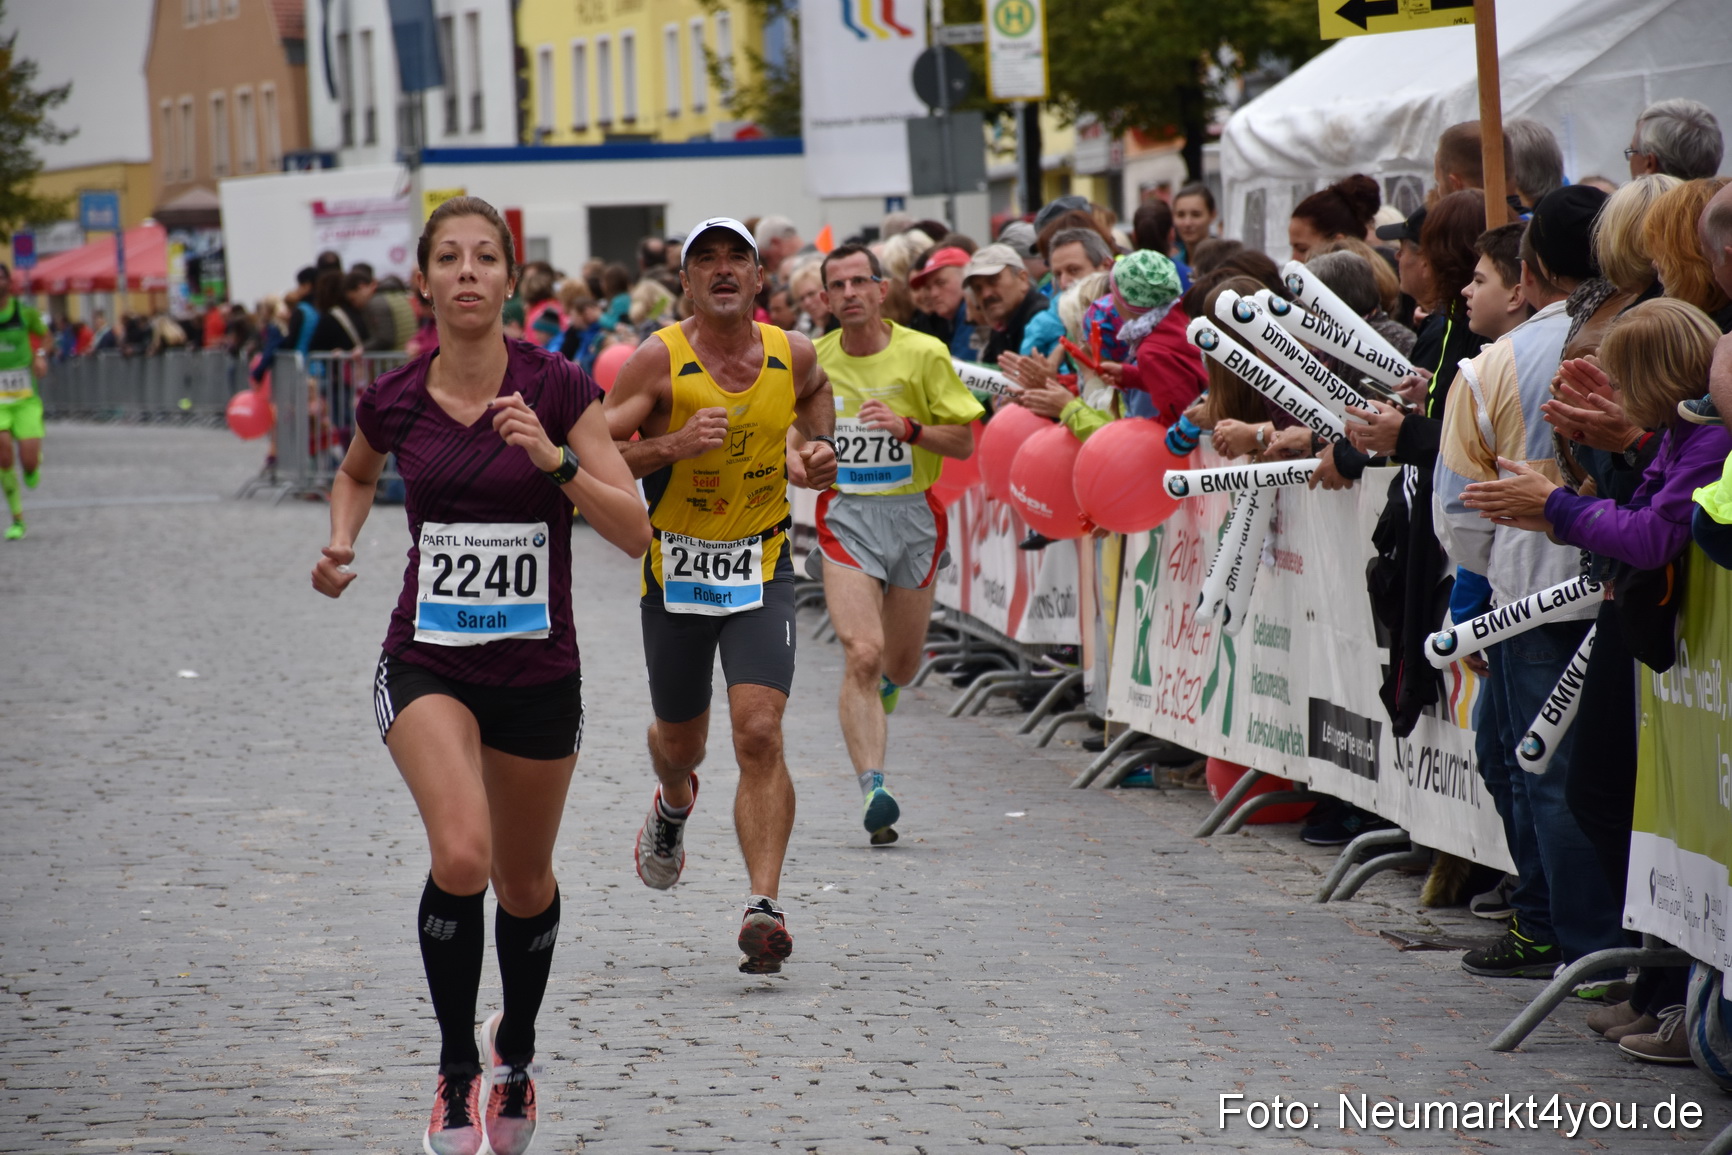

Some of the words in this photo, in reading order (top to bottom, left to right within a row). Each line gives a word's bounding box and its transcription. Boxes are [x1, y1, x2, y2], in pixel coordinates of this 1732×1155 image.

[1301, 312, 1353, 349] BMW
[1223, 349, 1278, 393] BMW
[837, 436, 904, 464] 2278
[692, 475, 720, 487] Seidl
[850, 471, 891, 482] Damian
[1201, 471, 1249, 493] BMW
[423, 534, 461, 546] PARTL
[464, 535, 528, 548] Neumarkt
[664, 531, 696, 546] PARTL
[698, 539, 746, 549] Neumarkt
[432, 553, 537, 598] 2240
[671, 547, 752, 580] 2464
[693, 587, 732, 604] Robert
[457, 610, 507, 628] Sarah
[1472, 597, 1532, 639] BMW
[1541, 661, 1586, 726] BMW
